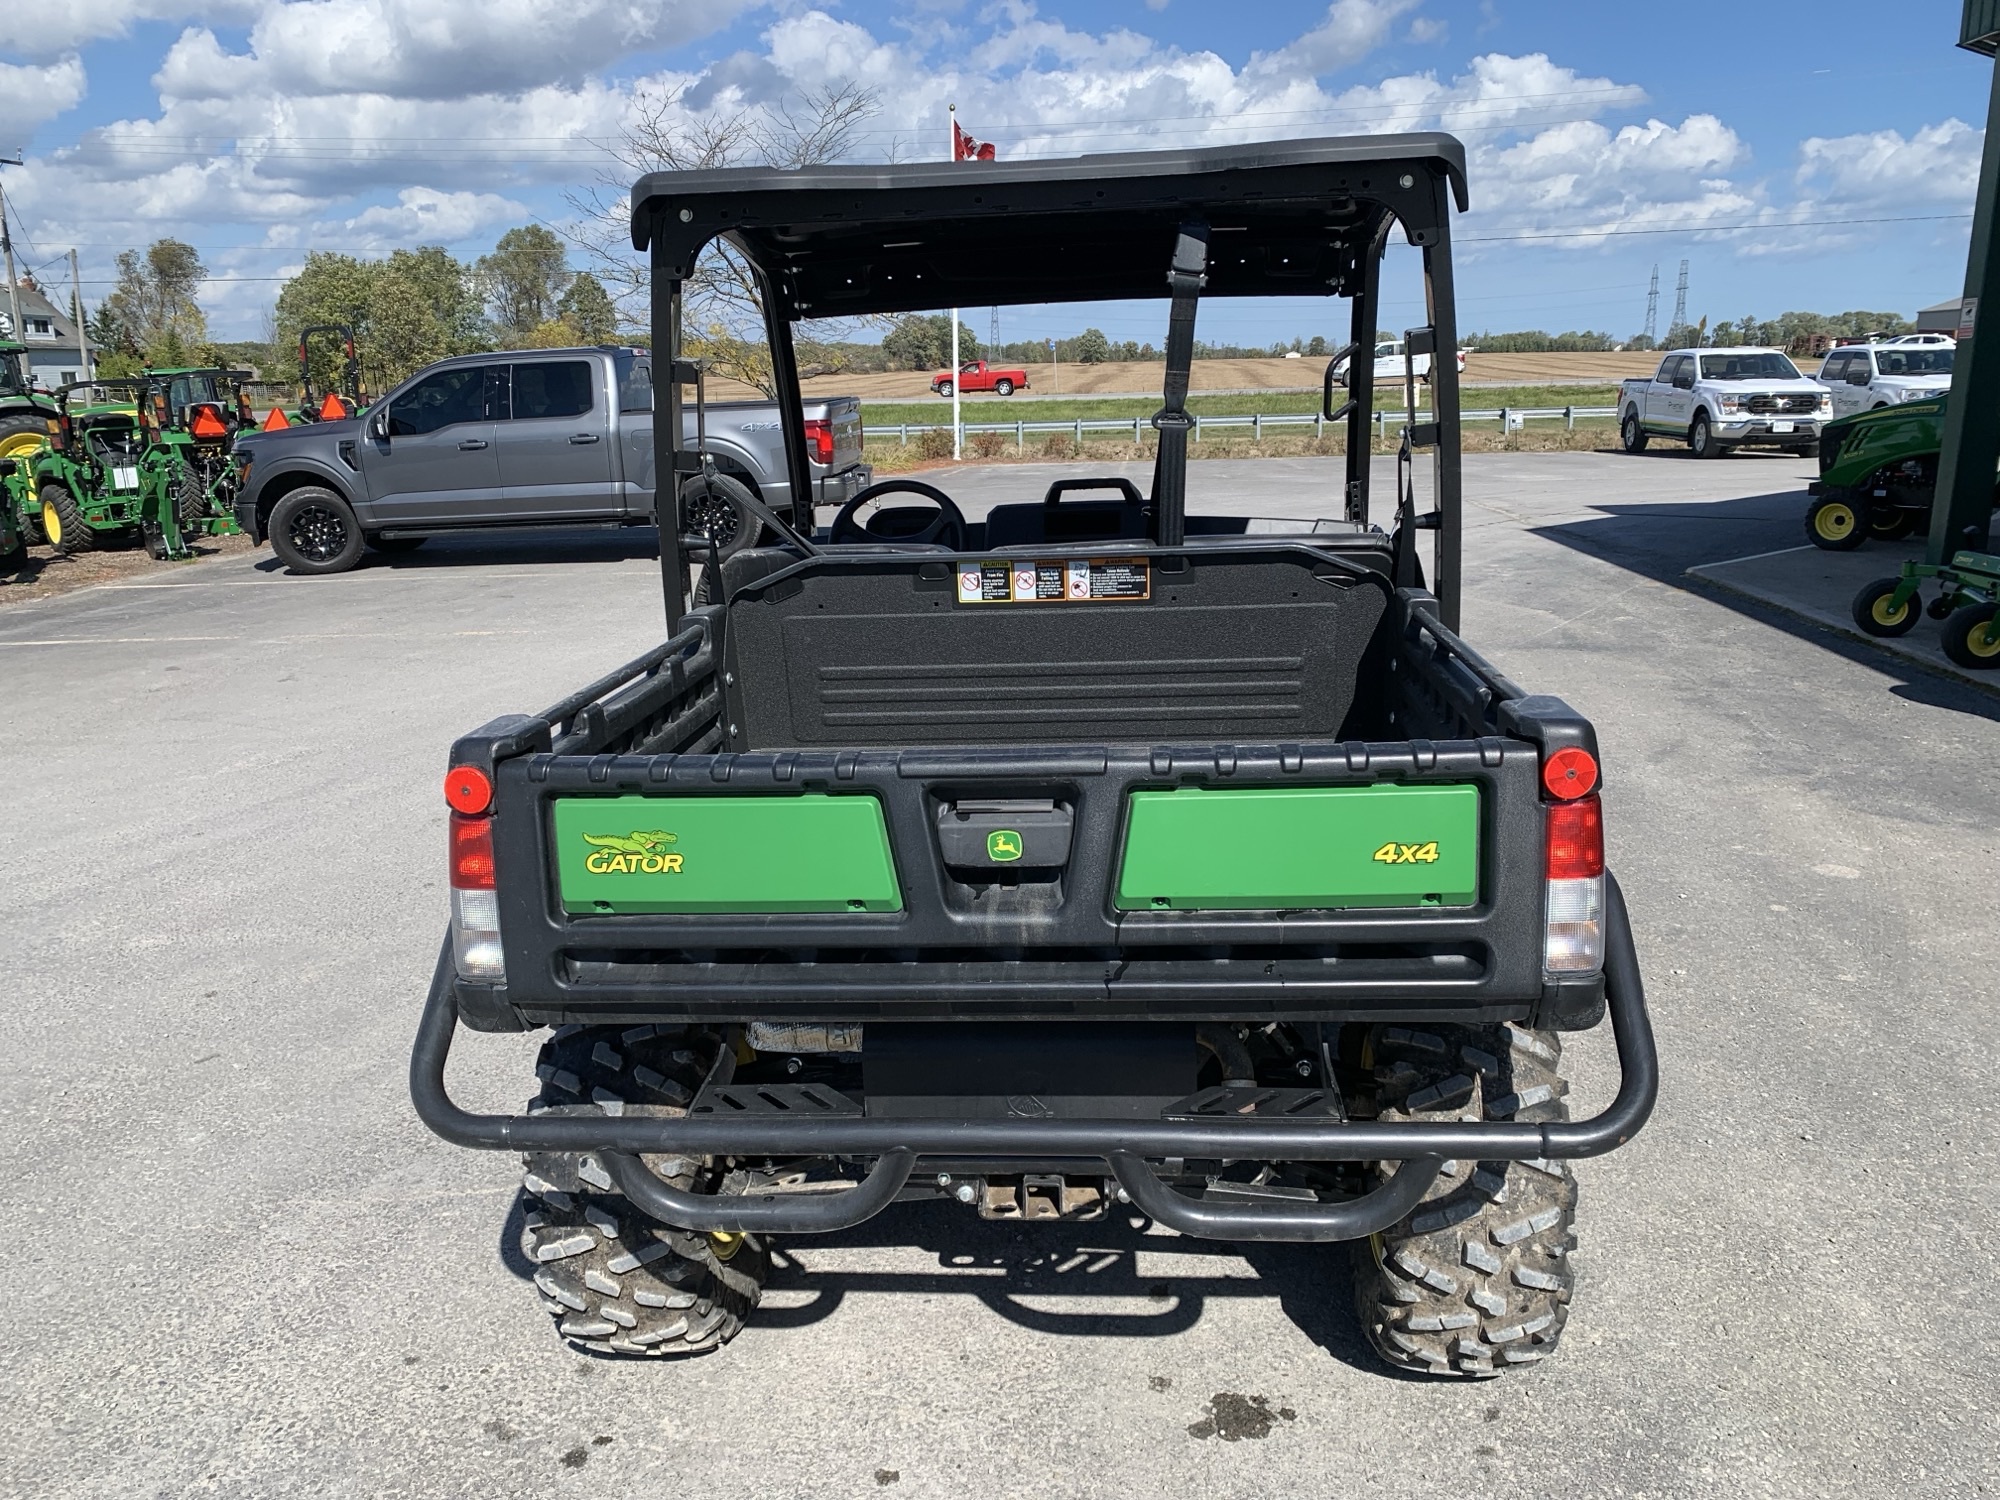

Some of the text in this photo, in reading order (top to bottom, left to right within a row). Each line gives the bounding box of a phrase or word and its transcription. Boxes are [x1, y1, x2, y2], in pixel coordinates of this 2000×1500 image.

[741, 421, 783, 433] 4x4
[585, 851, 684, 875] GATOR
[1373, 841, 1440, 865] 4x4
